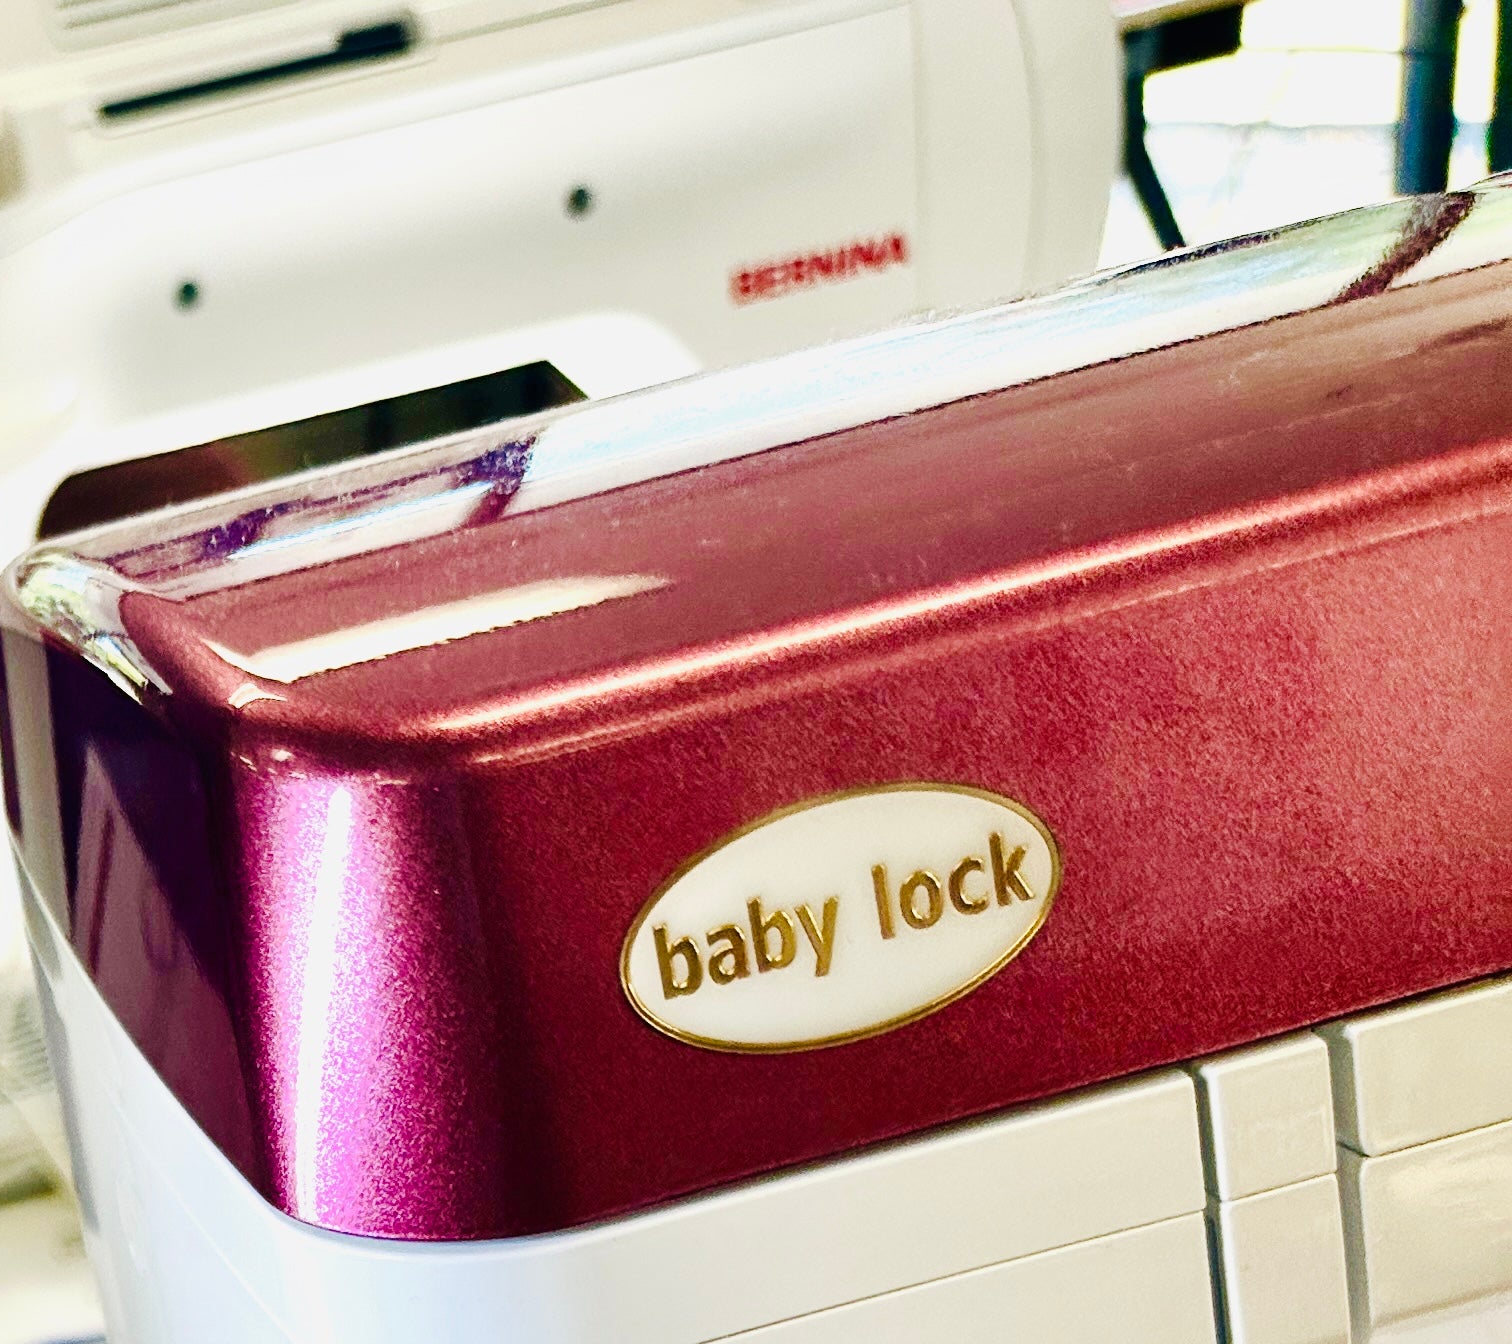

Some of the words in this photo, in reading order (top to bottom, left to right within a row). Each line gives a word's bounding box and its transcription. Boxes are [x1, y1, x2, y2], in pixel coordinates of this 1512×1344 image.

[732, 235, 908, 304] BERNINA
[652, 896, 838, 1000] baby
[870, 832, 1036, 940] lock
